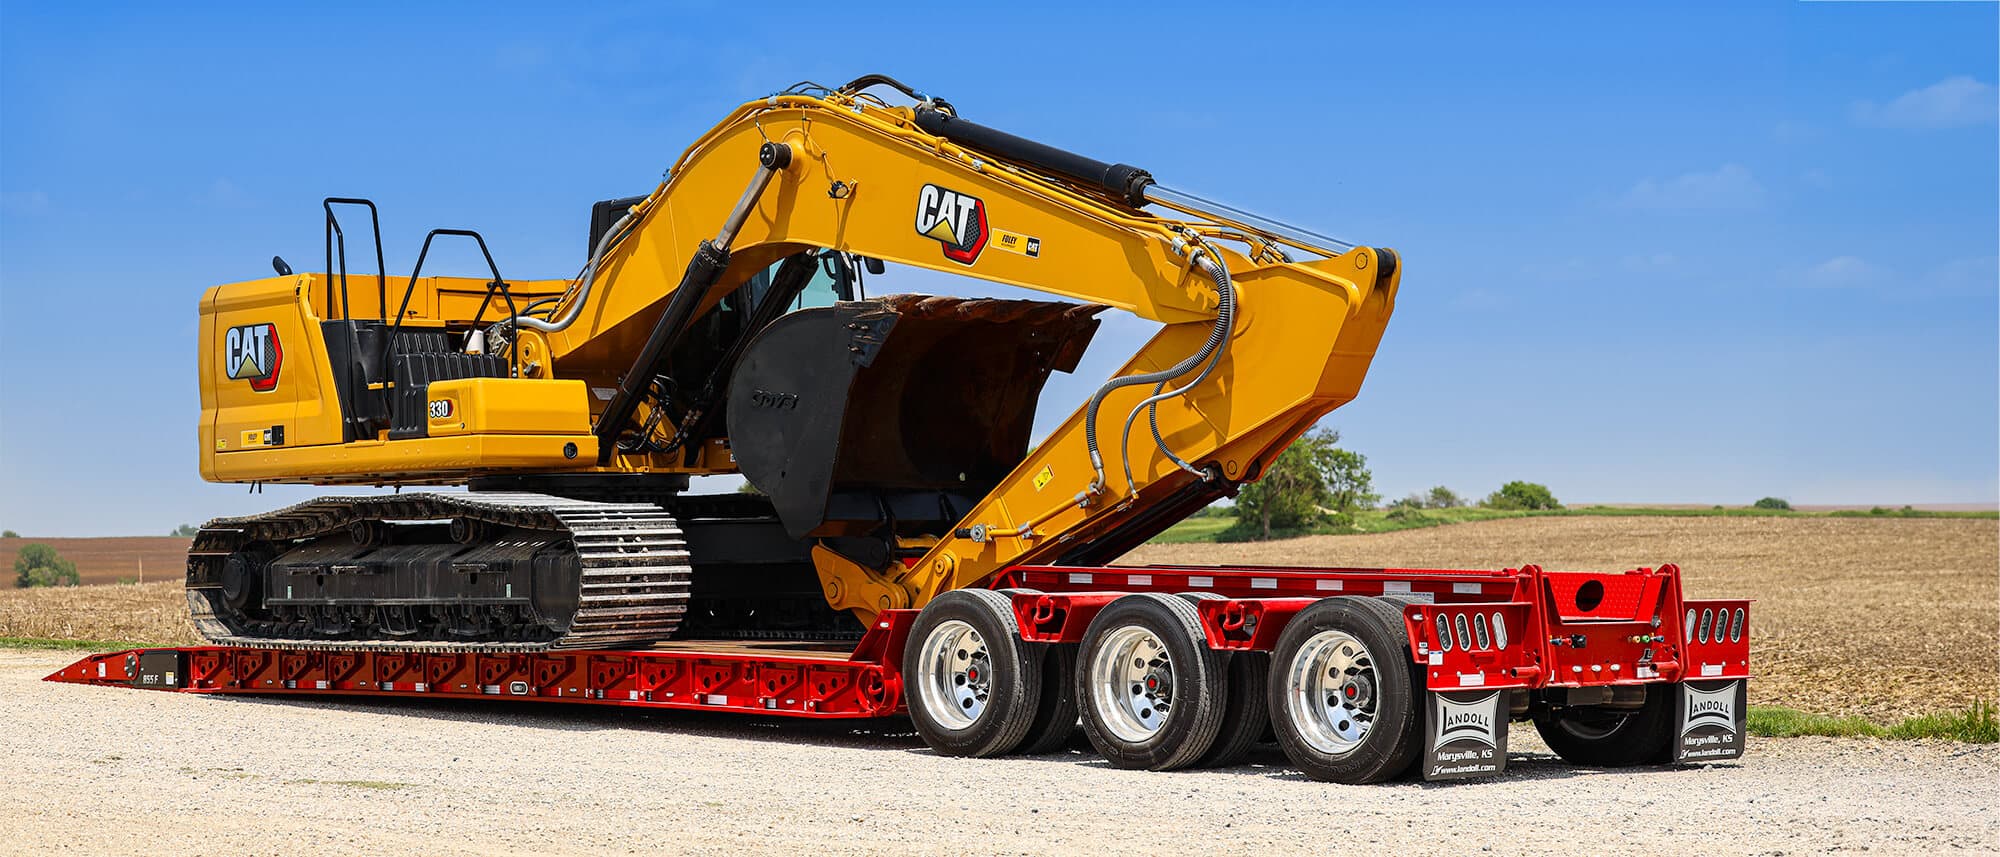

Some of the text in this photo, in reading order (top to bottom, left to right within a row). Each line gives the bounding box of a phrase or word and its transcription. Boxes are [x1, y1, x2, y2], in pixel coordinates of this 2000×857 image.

[916, 184, 976, 246] CAT
[1002, 235, 1017, 244] FOLEY
[1027, 241, 1039, 252] CAT
[226, 325, 269, 379] CAT
[429, 400, 449, 418] 330
[1687, 694, 1730, 723] LANDOLL
[1442, 706, 1490, 736] LANDOLL
[1684, 734, 1733, 747] Marysville, KS
[1437, 749, 1493, 762] Marysville, KS
